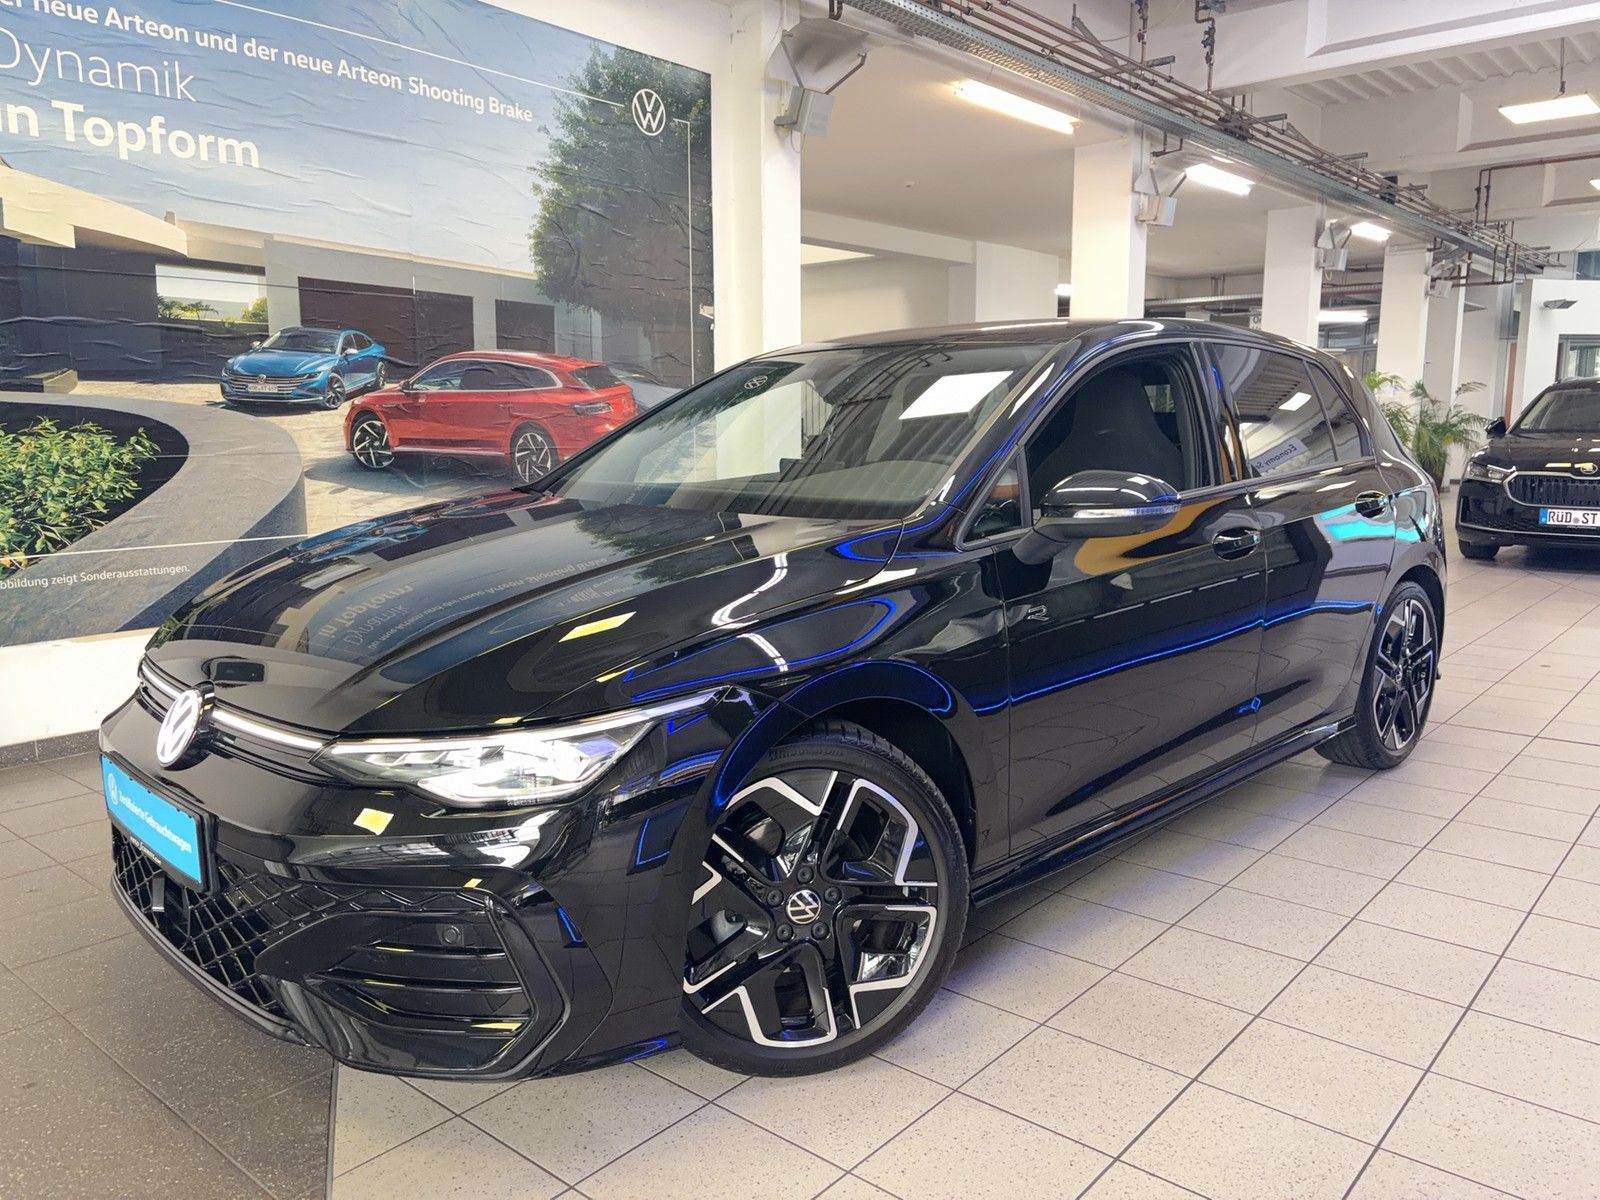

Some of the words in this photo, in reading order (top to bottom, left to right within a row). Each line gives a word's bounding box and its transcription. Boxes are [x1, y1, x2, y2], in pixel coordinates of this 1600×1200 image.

[34, 0, 98, 24] neue
[104, 7, 189, 43] Arteon
[195, 31, 237, 53] und
[243, 38, 278, 62] der
[283, 49, 333, 74] neue
[337, 59, 402, 89] Arteon
[408, 77, 485, 114] Shooting
[489, 97, 533, 122] Brake
[51, 99, 260, 168] Topform
[1548, 511, 1572, 523] RÜD
[1581, 512, 1598, 524] ST
[51, 574, 78, 585] zeigt
[80, 564, 190, 582] Sonderausstattungen.
